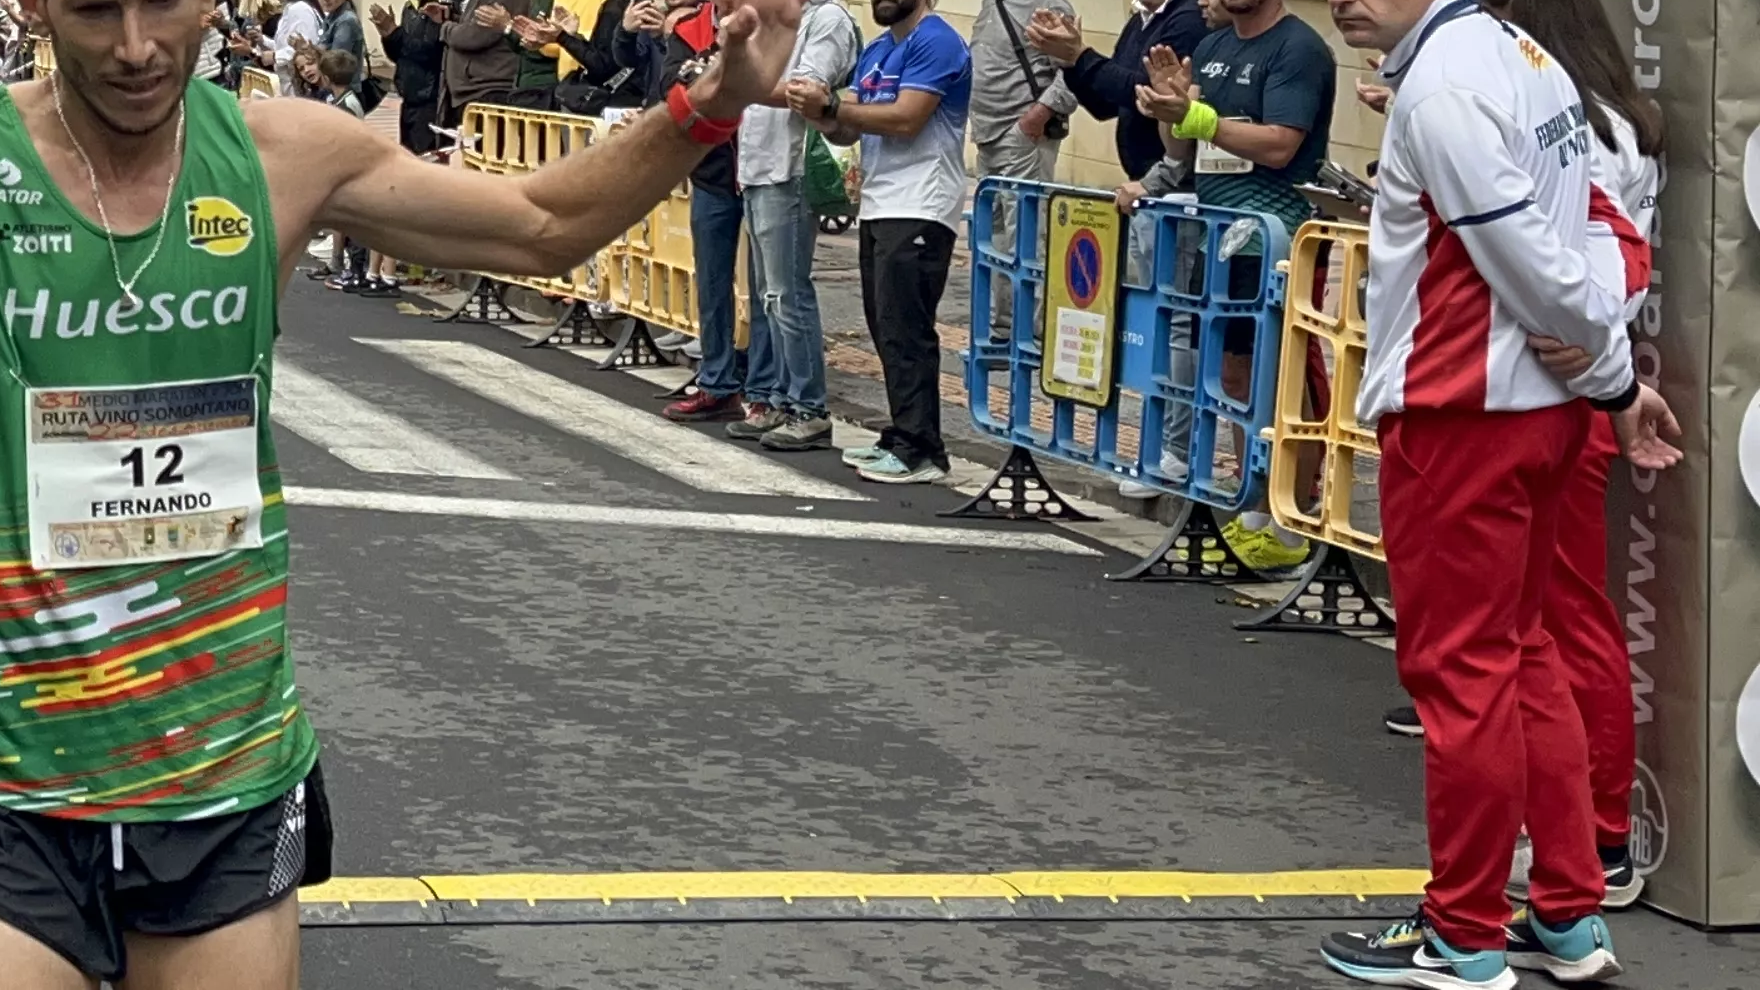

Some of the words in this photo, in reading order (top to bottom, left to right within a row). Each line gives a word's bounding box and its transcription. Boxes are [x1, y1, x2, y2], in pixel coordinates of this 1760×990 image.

[13, 233, 73, 254] ZOITI
[3, 285, 248, 340] Huesca
[41, 411, 89, 426] RUTA
[94, 409, 140, 424] VINO
[143, 398, 250, 421] SOMONTANO
[120, 443, 184, 487] 12
[90, 492, 212, 518] FERNANDO
